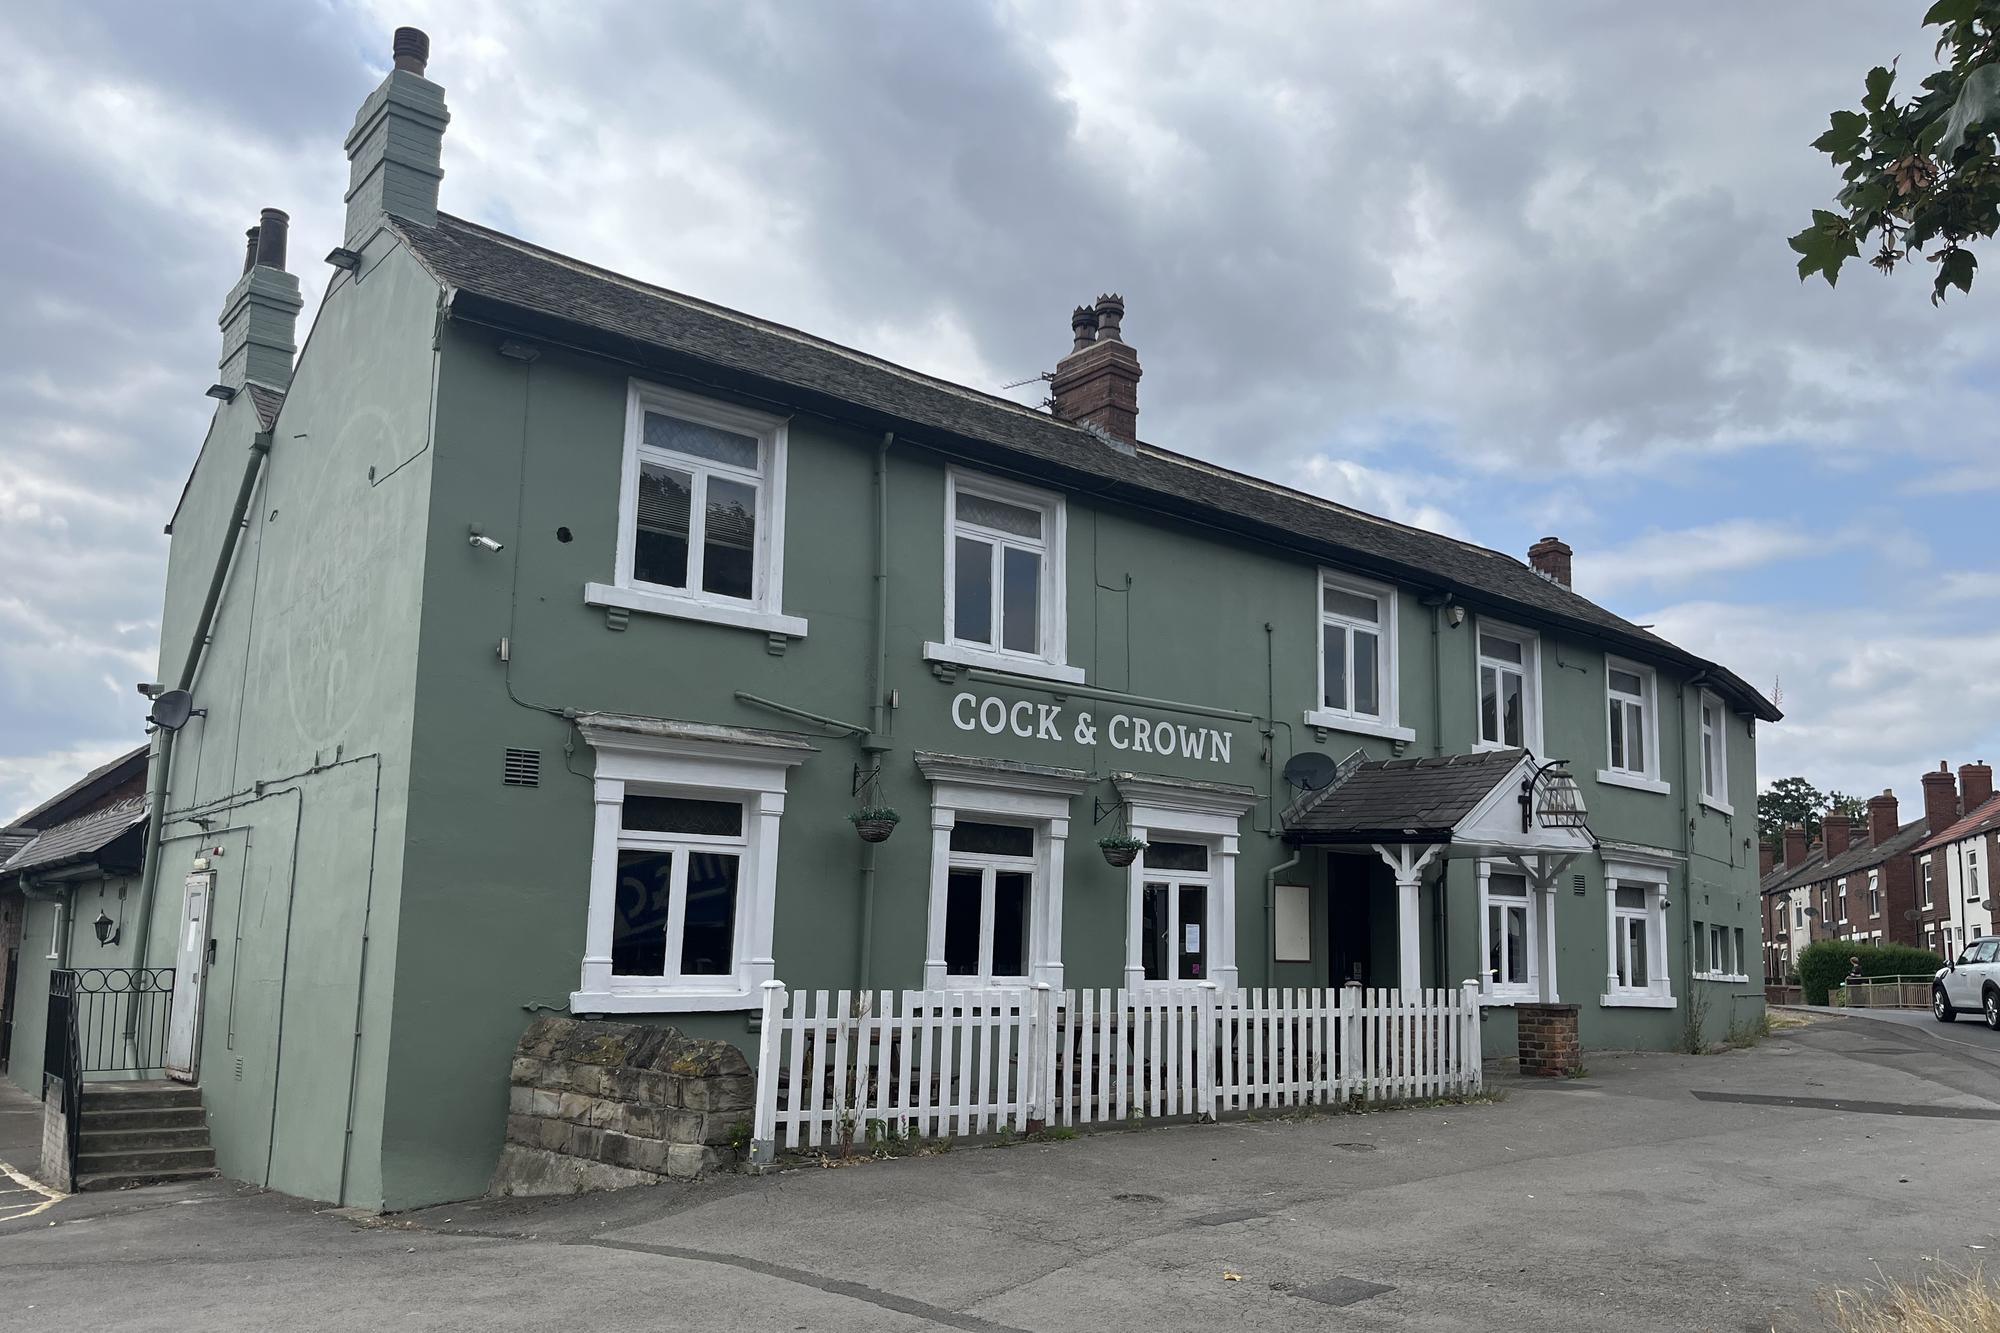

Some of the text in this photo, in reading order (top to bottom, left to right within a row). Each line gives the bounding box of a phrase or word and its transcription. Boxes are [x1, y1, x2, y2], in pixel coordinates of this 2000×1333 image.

[951, 692, 1232, 763] COCK & CROWN
